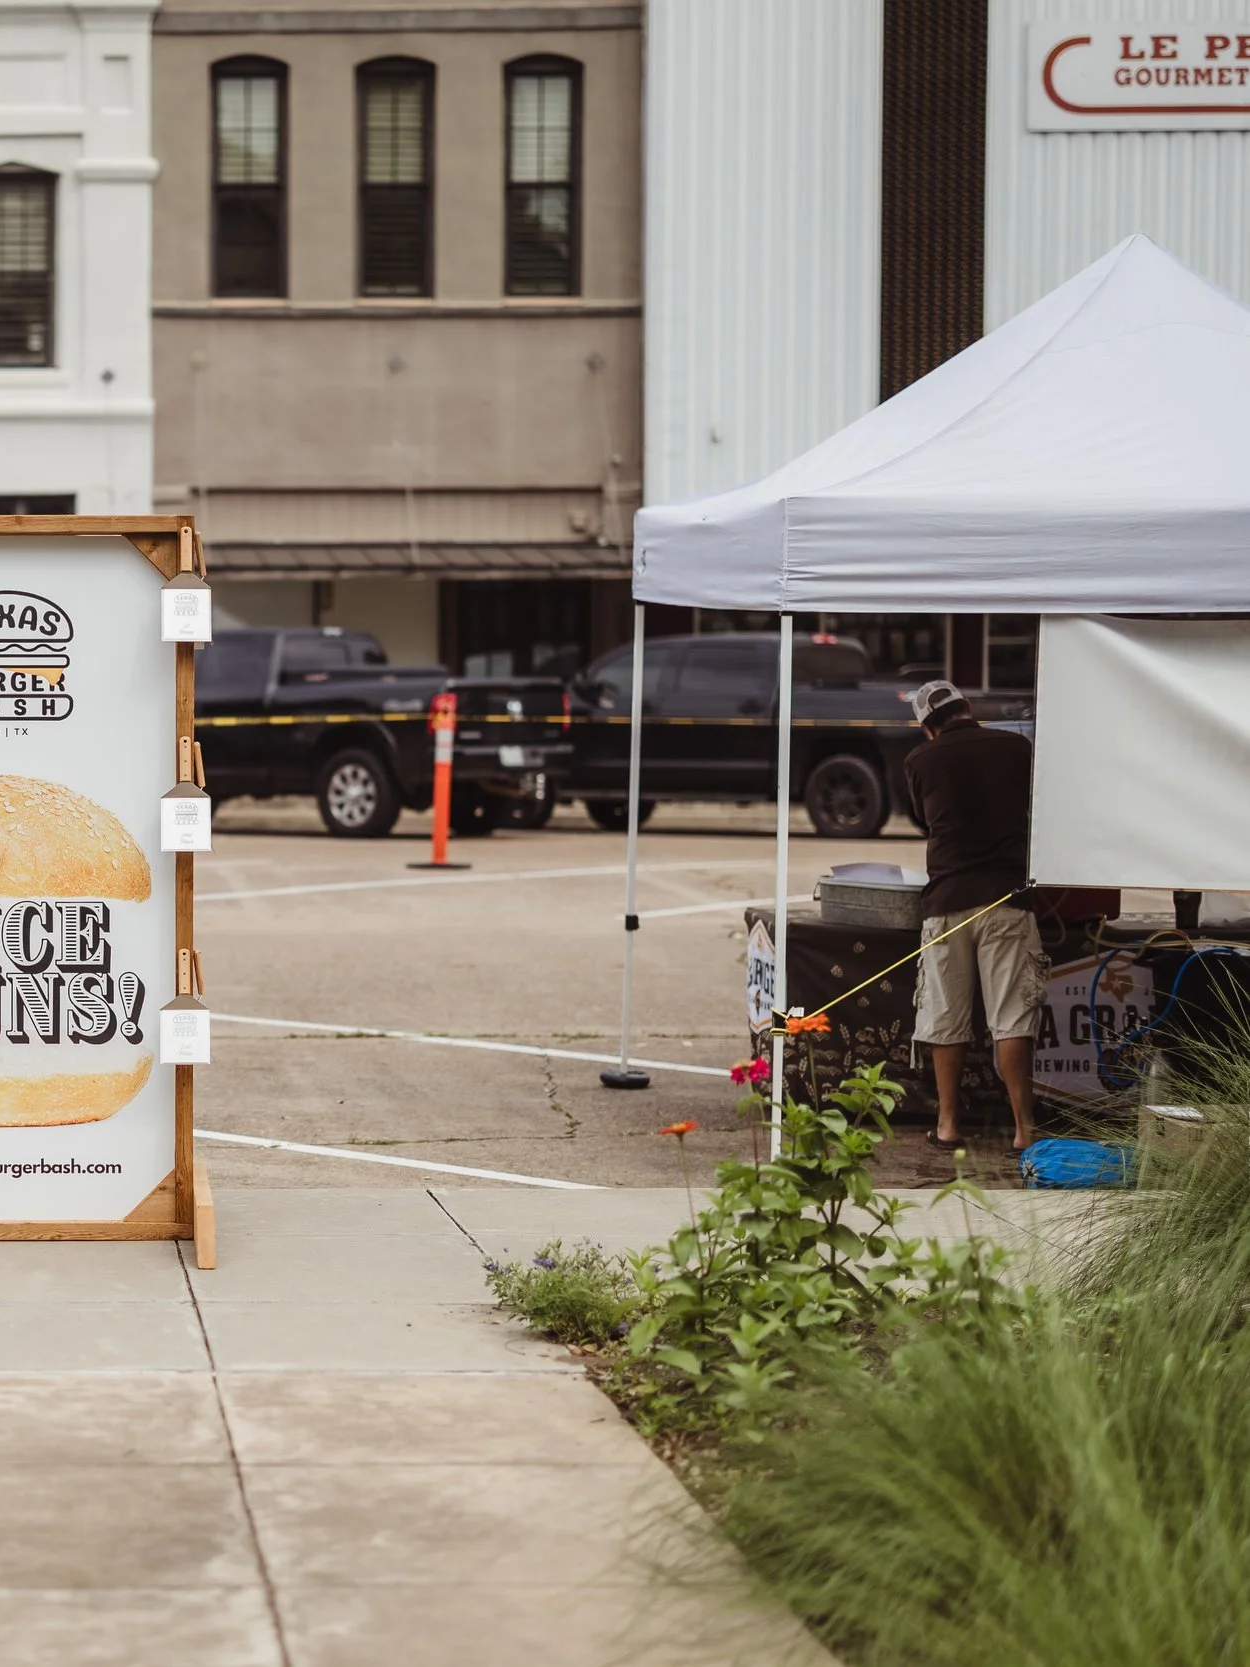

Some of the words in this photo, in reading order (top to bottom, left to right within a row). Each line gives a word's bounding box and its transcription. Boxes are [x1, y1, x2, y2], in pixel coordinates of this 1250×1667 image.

[1119, 35, 1178, 60] LE
[1114, 67, 1250, 86] GOURMET
[14, 728, 29, 736] TX
[1033, 1003, 1060, 1051] A
[1034, 1060, 1090, 1073] REWING
